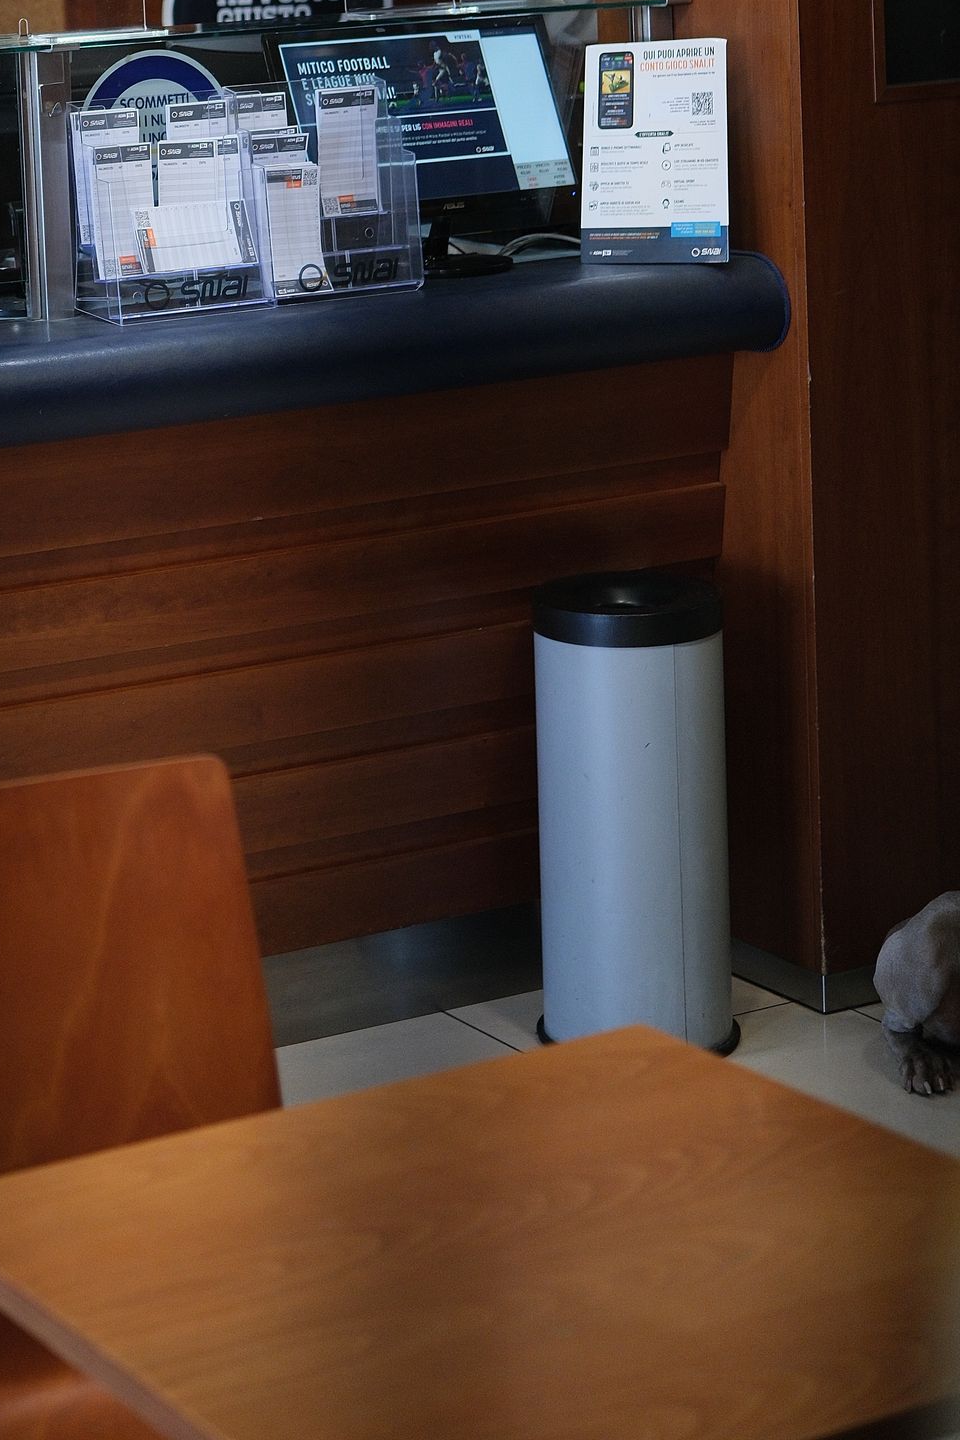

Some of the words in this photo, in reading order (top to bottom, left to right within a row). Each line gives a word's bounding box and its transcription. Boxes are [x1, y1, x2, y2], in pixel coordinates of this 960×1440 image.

[643, 49, 656, 61] QUI
[657, 49, 675, 60] PUOI
[676, 47, 702, 59] APRIRE
[704, 46, 715, 56] UN
[297, 60, 335, 76] MITICO
[337, 56, 390, 72] FOOTBALL
[640, 61, 663, 72] CONTO
[665, 60, 688, 71] GIOCO
[302, 77, 309, 91] E
[311, 75, 352, 90] LEAGUE
[119, 92, 189, 109] SCOMMETTI
